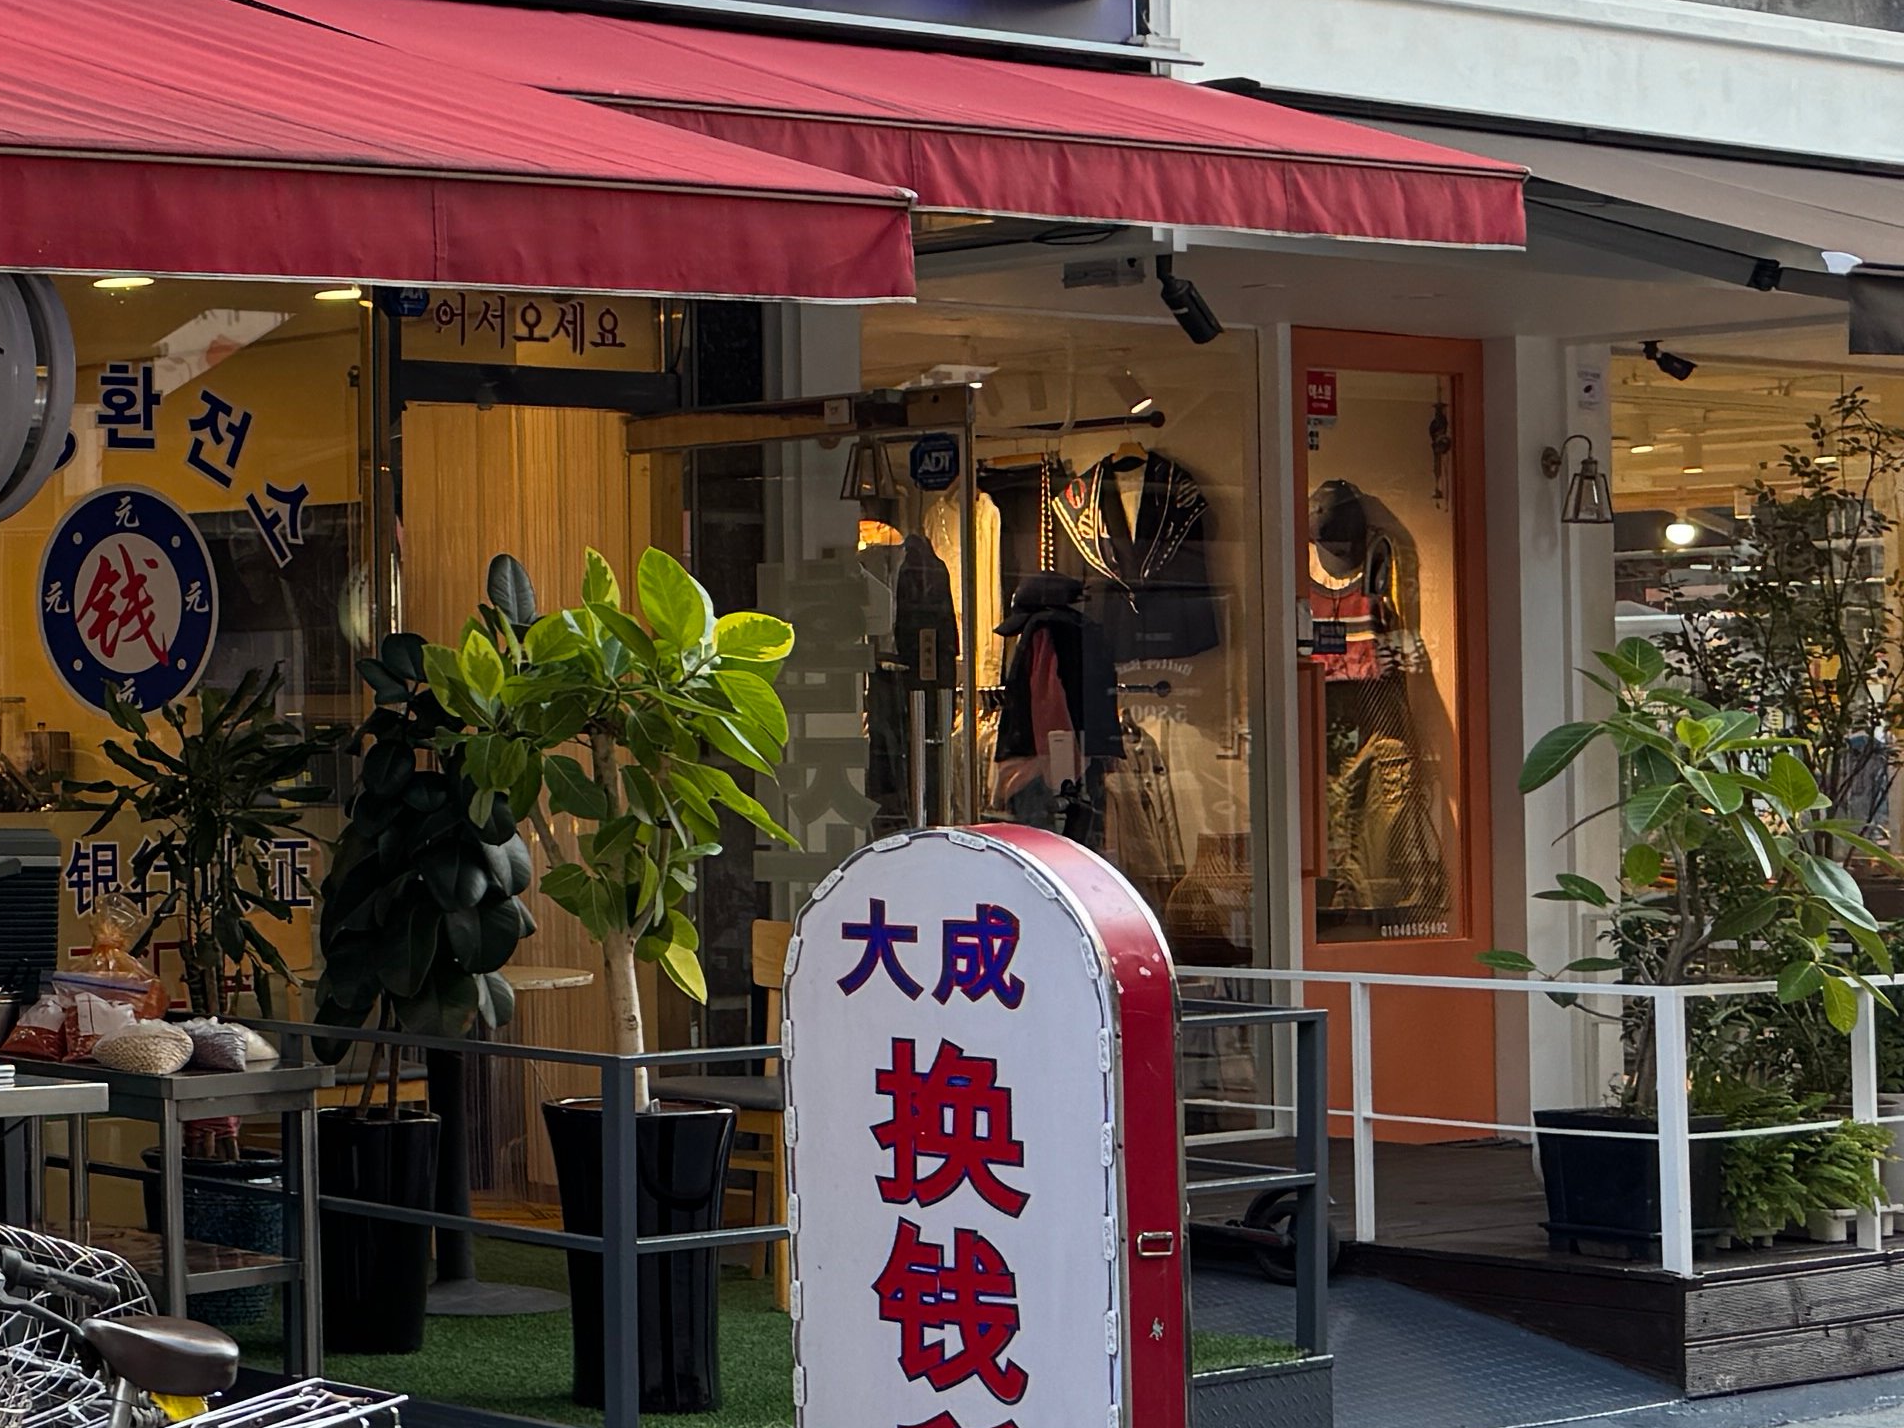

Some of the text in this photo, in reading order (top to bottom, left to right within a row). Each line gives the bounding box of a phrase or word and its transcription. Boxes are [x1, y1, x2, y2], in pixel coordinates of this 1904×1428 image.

[434, 291, 627, 356] 어서오세요
[97, 362, 309, 569] 환전소
[918, 451, 950, 473] ADT
[837, 898, 1026, 1010] 大成
